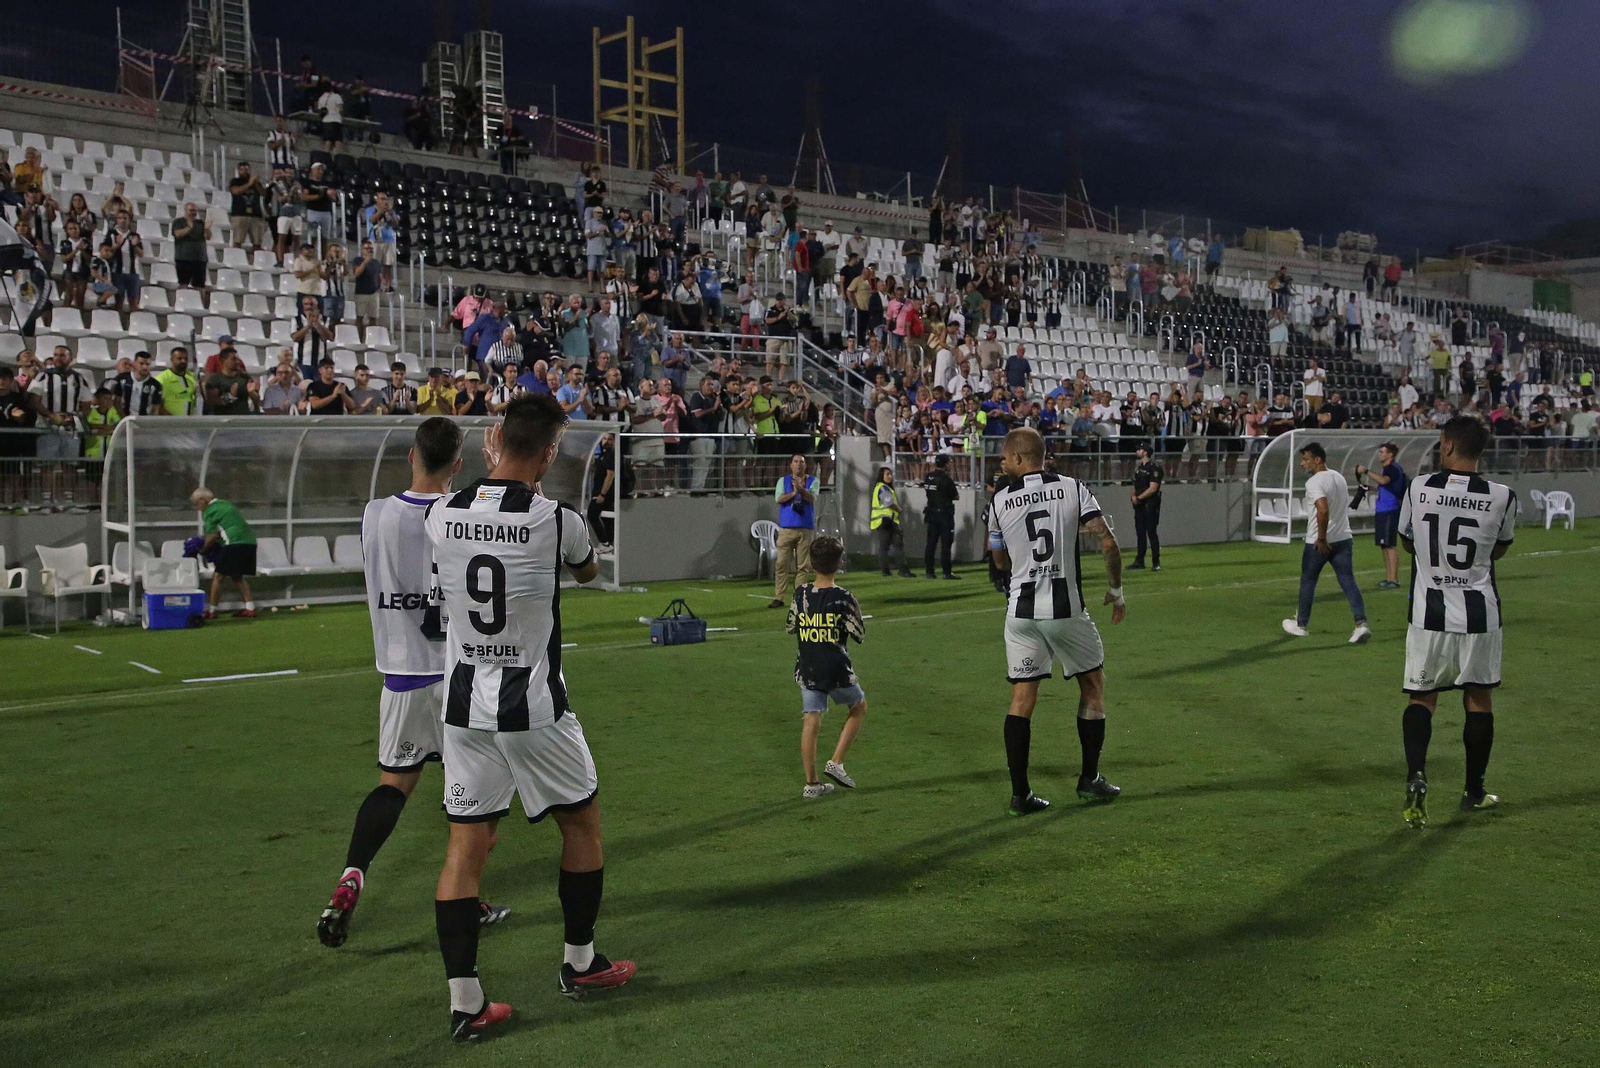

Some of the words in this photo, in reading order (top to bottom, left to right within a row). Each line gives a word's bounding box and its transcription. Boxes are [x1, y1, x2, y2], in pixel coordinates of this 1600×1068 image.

[1005, 488, 1064, 511] MORCILLO
[1419, 493, 1430, 504] D.
[1436, 494, 1492, 512] JIMÉNEZ
[445, 521, 530, 544] TOLEDANO
[1025, 509, 1054, 563] 5
[1422, 513, 1479, 570] 15
[466, 554, 507, 636] 9
[799, 613, 841, 627] SMILEY
[799, 628, 840, 642] WORLD
[476, 644, 520, 657] BFUEL
[479, 656, 518, 665] Gasolineras
[453, 797, 479, 807] Galán
